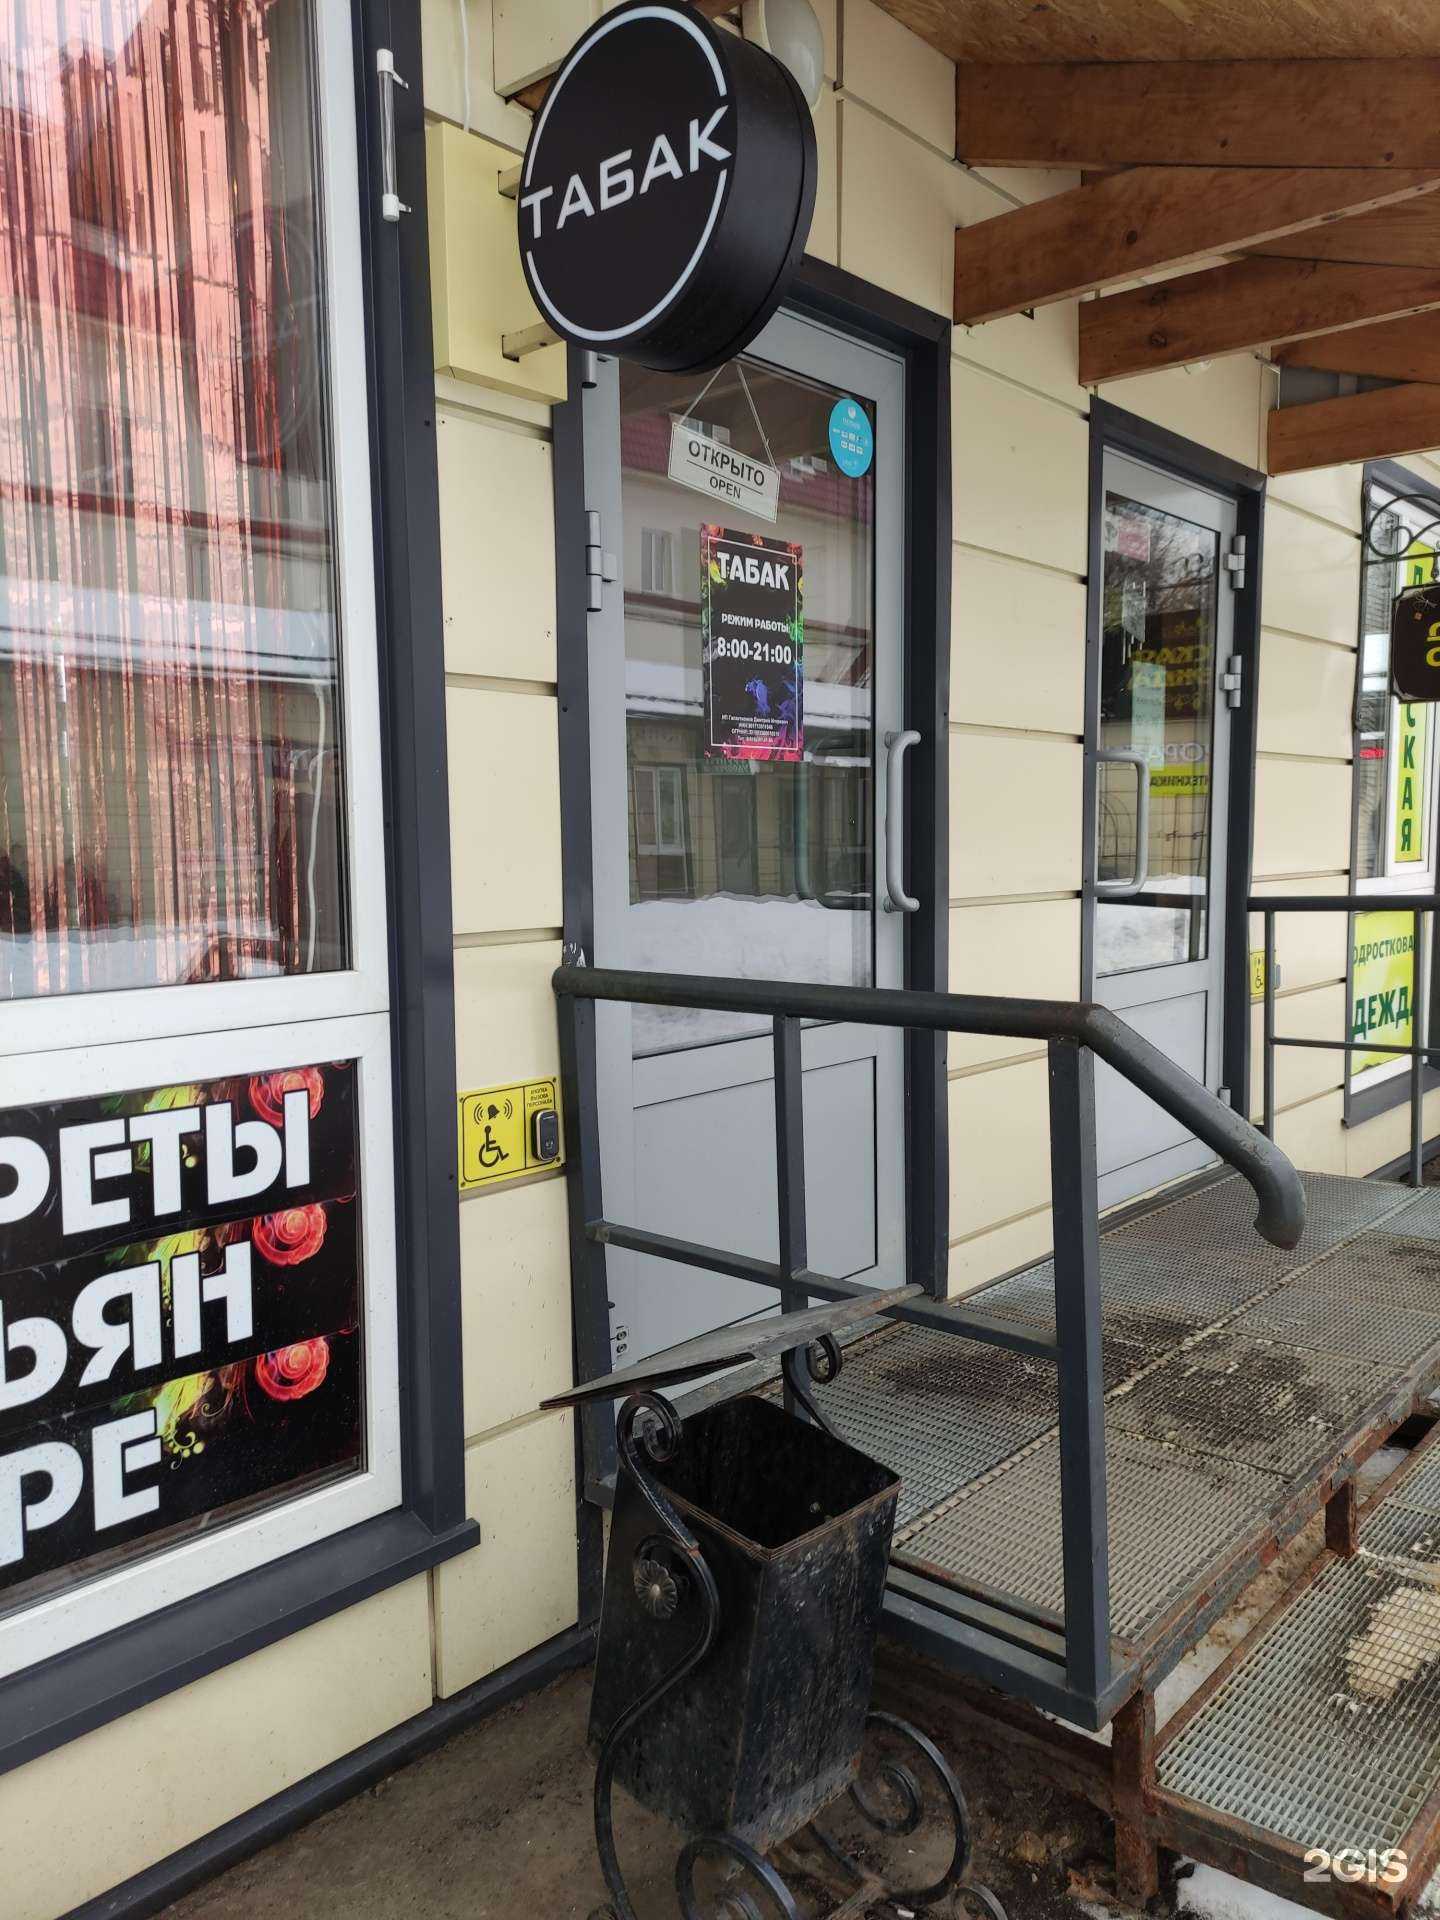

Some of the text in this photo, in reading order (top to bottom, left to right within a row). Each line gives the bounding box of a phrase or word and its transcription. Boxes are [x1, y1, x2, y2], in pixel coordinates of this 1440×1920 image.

[520, 104, 733, 240] ТАБАК
[688, 440, 765, 487] ОТКРЫТО
[709, 476, 741, 499] OPEN
[717, 552, 790, 591] ТАБАК
[721, 613, 754, 628] РЕЖИМ
[717, 636, 792, 665] 8:00-21:00
[1352, 934, 1415, 967] ОДРОСТКОВА
[1352, 985, 1414, 1041] ДЕЖД
[0, 1408, 162, 1568] РЕ
